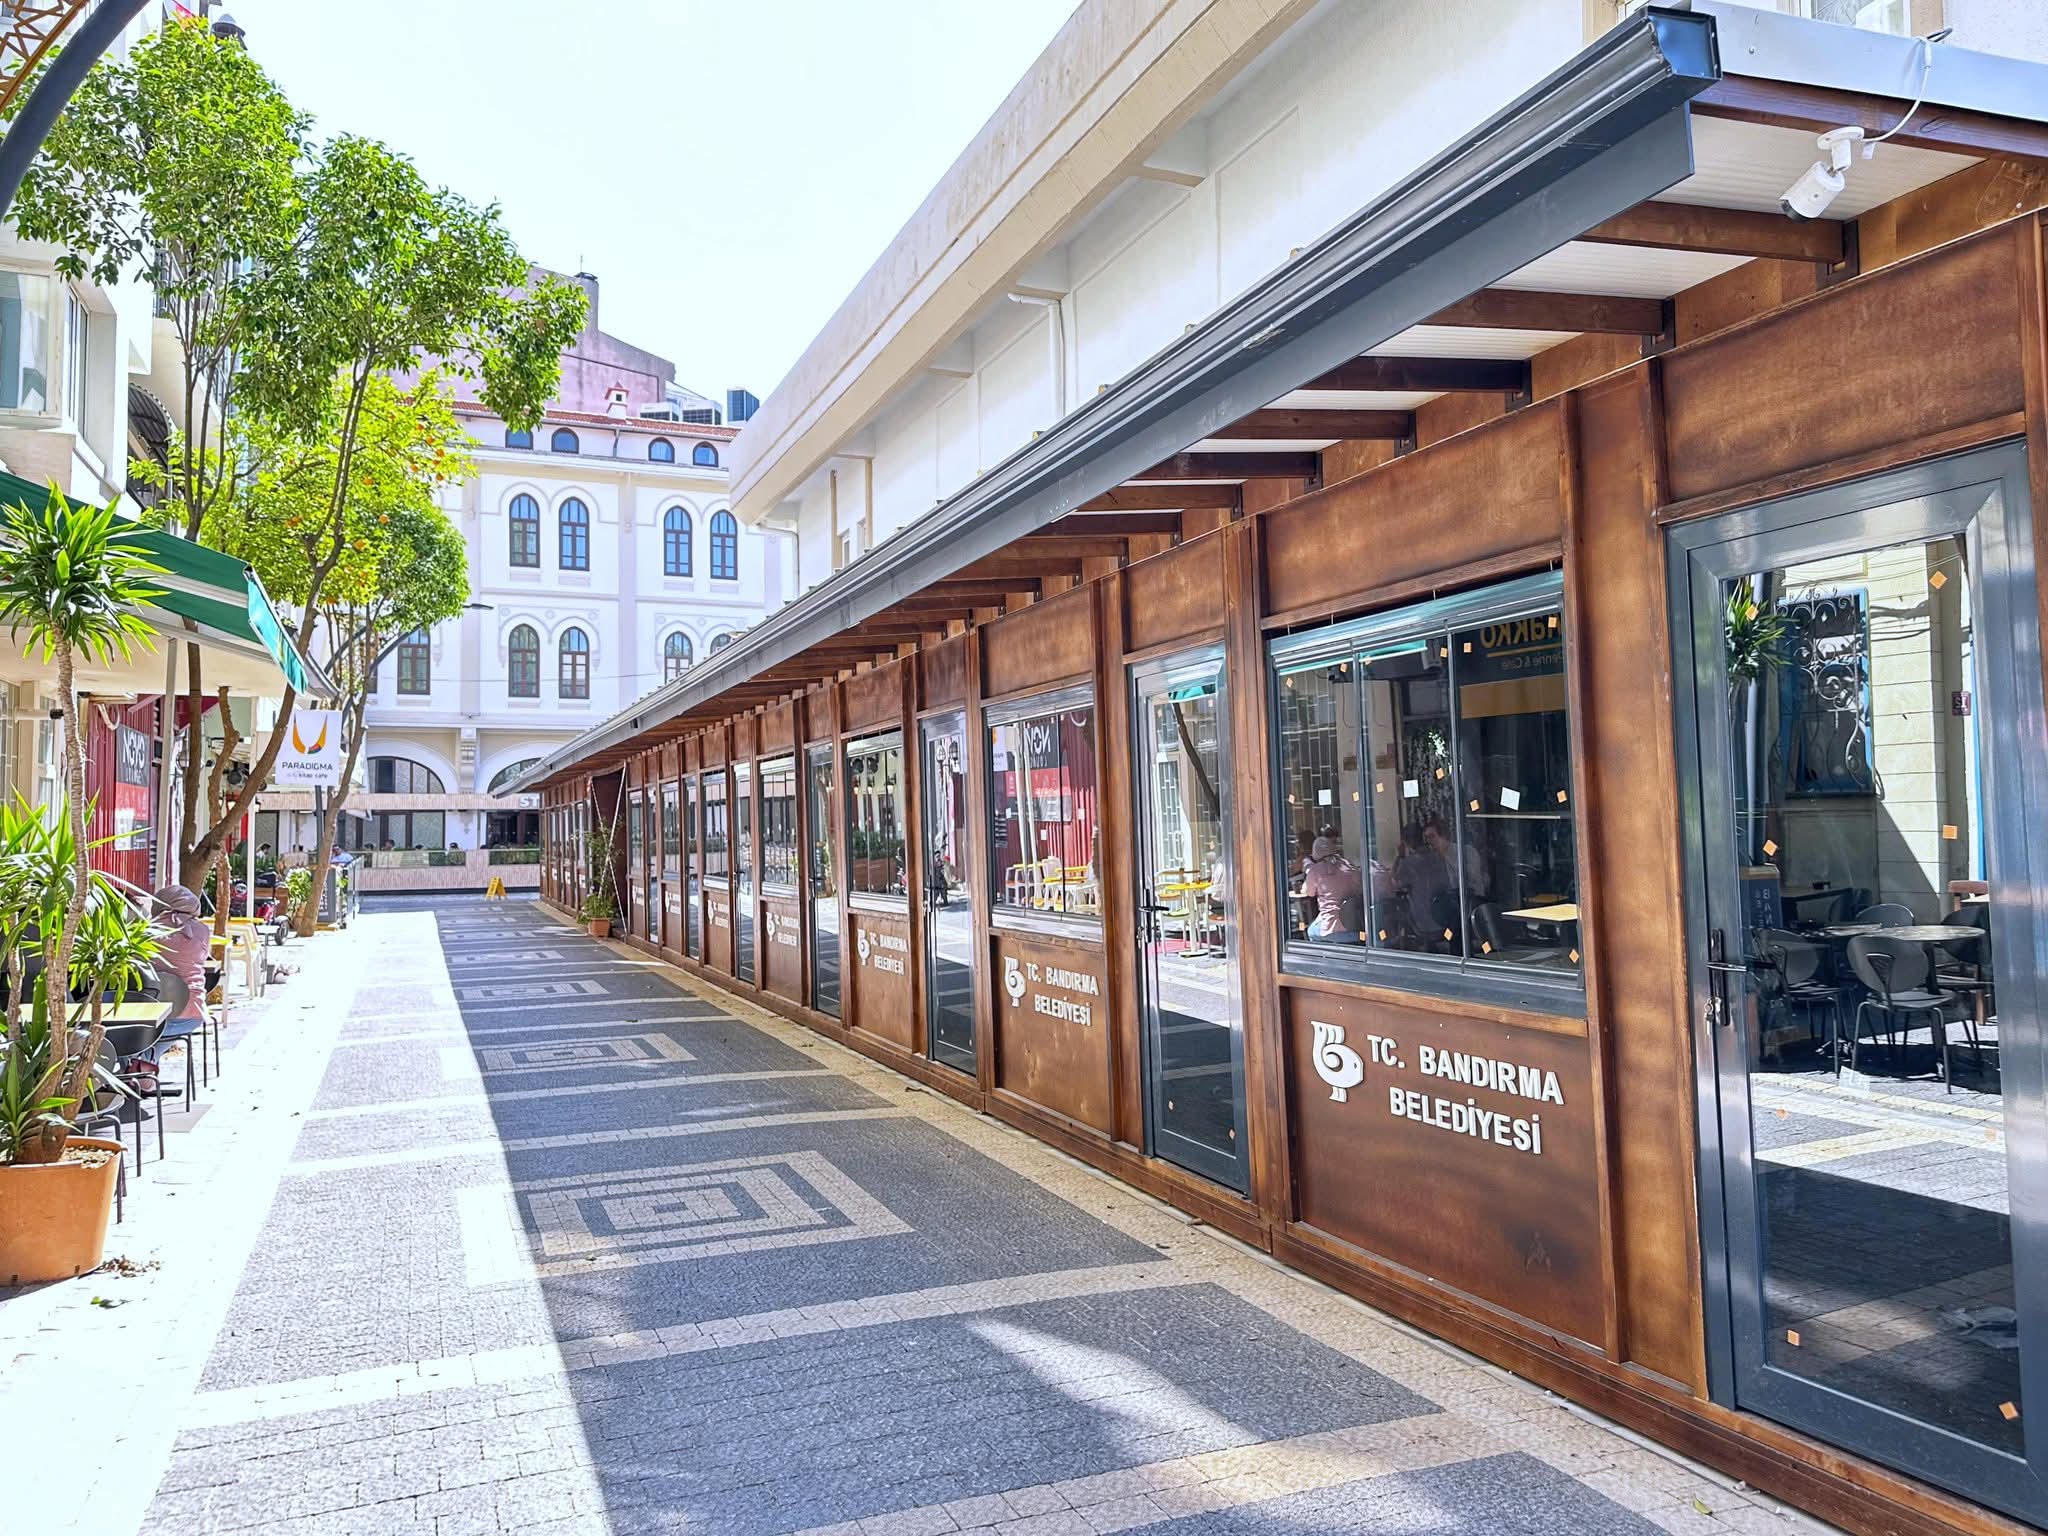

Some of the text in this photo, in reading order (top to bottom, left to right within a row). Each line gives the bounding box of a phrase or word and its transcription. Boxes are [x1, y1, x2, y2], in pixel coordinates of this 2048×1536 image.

[282, 762, 333, 771] PARADIGMA
[1046, 966, 1099, 996] BANDIRMA
[1034, 994, 1091, 1026] BELEDİYESİ
[1419, 1045, 1565, 1105] BANDIRMA
[1389, 1087, 1542, 1154] BELEDİYESİ
